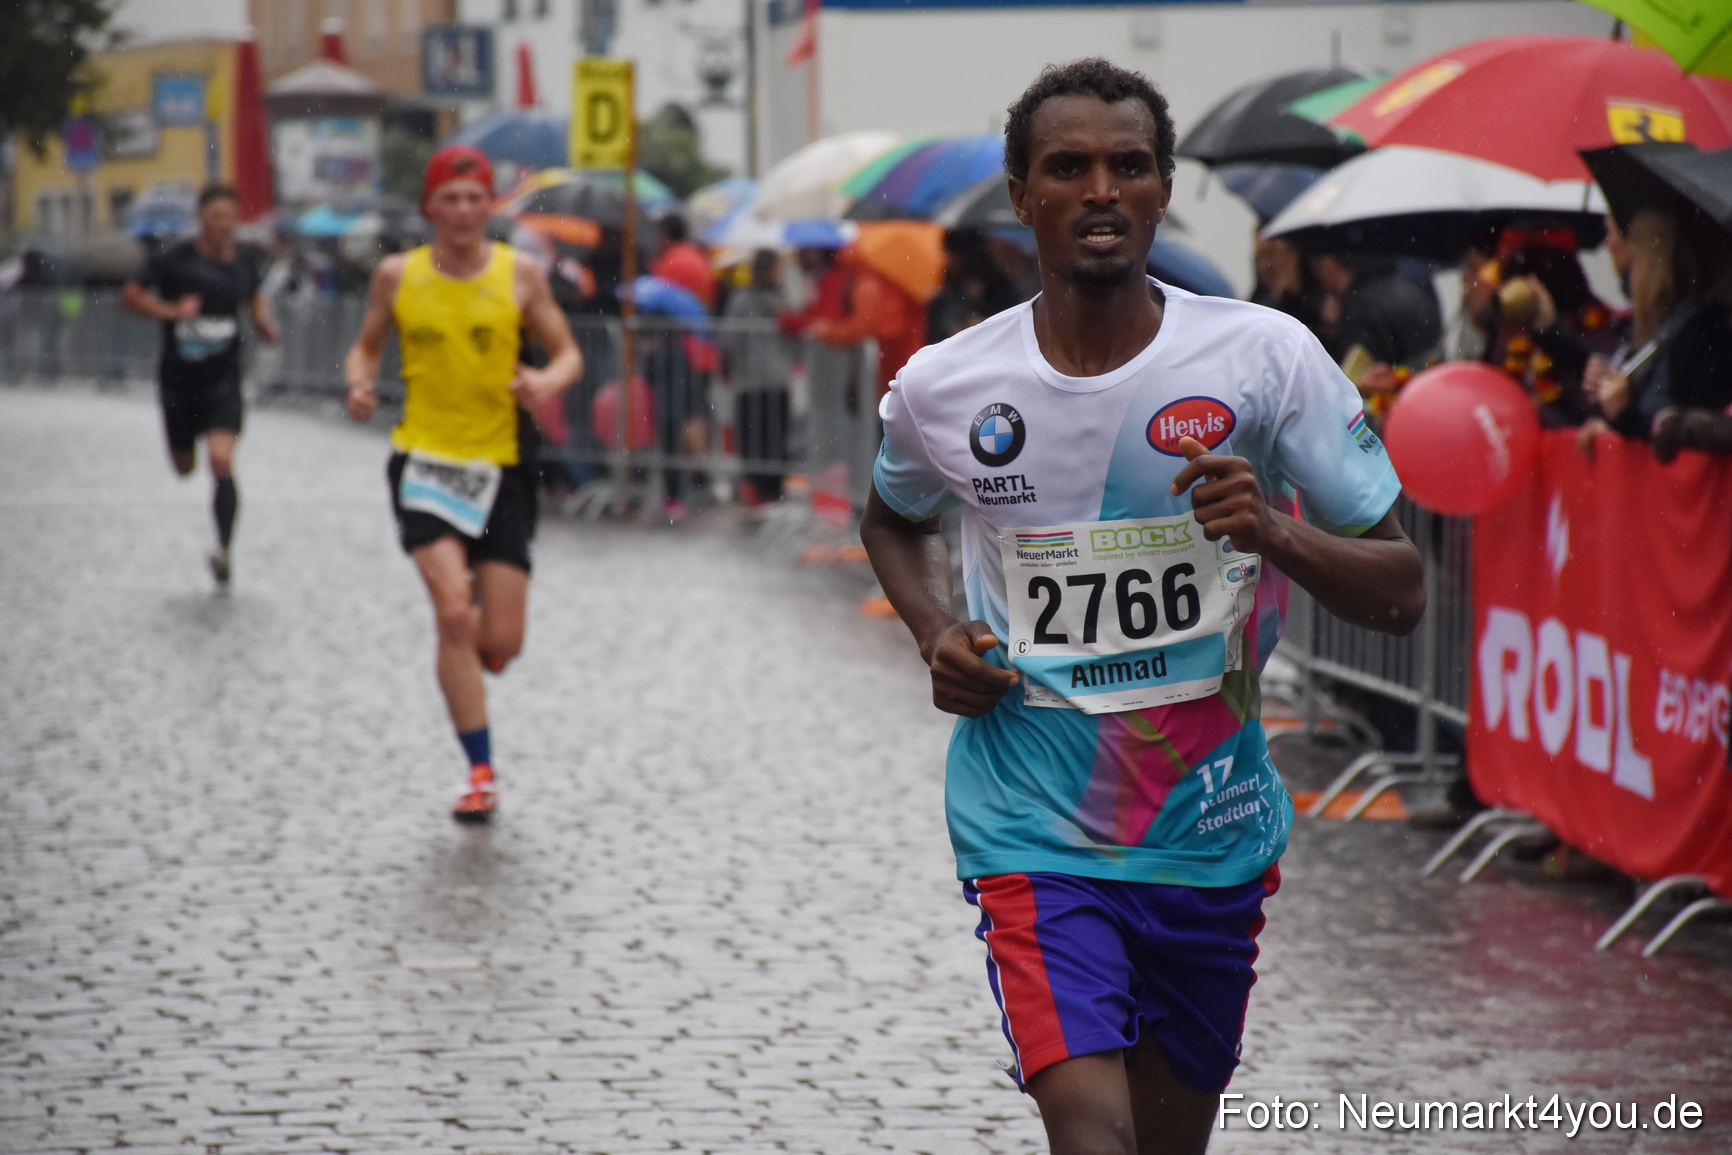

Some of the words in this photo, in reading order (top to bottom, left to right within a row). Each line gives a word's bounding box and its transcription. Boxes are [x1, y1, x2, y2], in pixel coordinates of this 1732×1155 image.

[586, 91, 620, 144] D
[974, 404, 1020, 426] BMW
[1159, 412, 1225, 440] Hervis
[972, 474, 1035, 493] PARTL
[977, 491, 1037, 506] Neumarkt
[1091, 520, 1193, 552] BOCK
[1016, 547, 1079, 561] NeuerMarkt
[1092, 552, 1124, 561] inspired
[1125, 551, 1135, 560] by
[1137, 549, 1160, 558] smart
[1162, 543, 1195, 556] concepts
[1028, 562, 1201, 644] 2766
[1071, 651, 1167, 689] Ahmad
